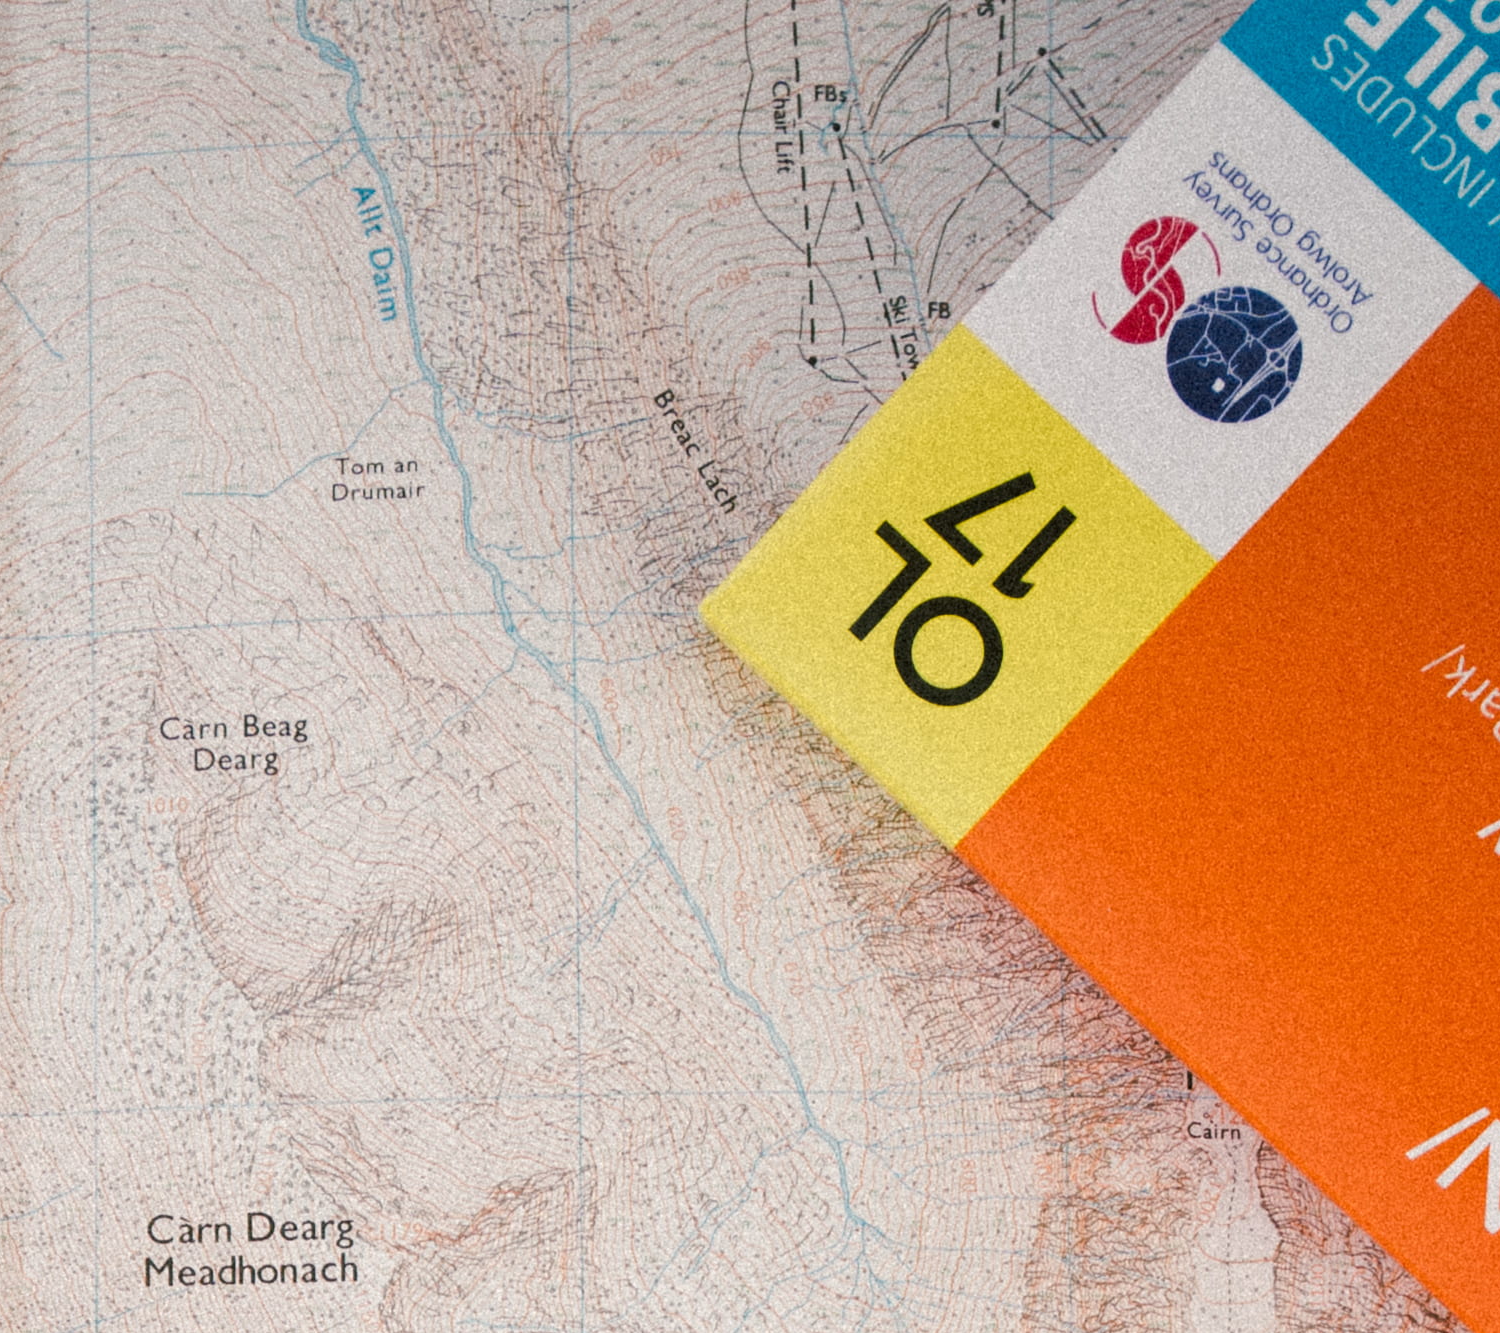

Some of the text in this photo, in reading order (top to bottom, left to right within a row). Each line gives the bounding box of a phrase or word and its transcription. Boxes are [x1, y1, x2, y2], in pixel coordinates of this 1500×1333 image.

[1310, 33, 1496, 208] INCLUDES
[1182, 167, 1357, 336] Ordnance Survey
[1208, 147, 1377, 311] Arolwg Ordnans
[921, 469, 1079, 602] 17
[846, 517, 1005, 708] OL
[158, 712, 310, 745] Càrn Beag
[193, 747, 280, 778] Dearg
[143, 1252, 360, 1288] Meadhonach
[146, 1212, 357, 1252] Càrn Dearg
